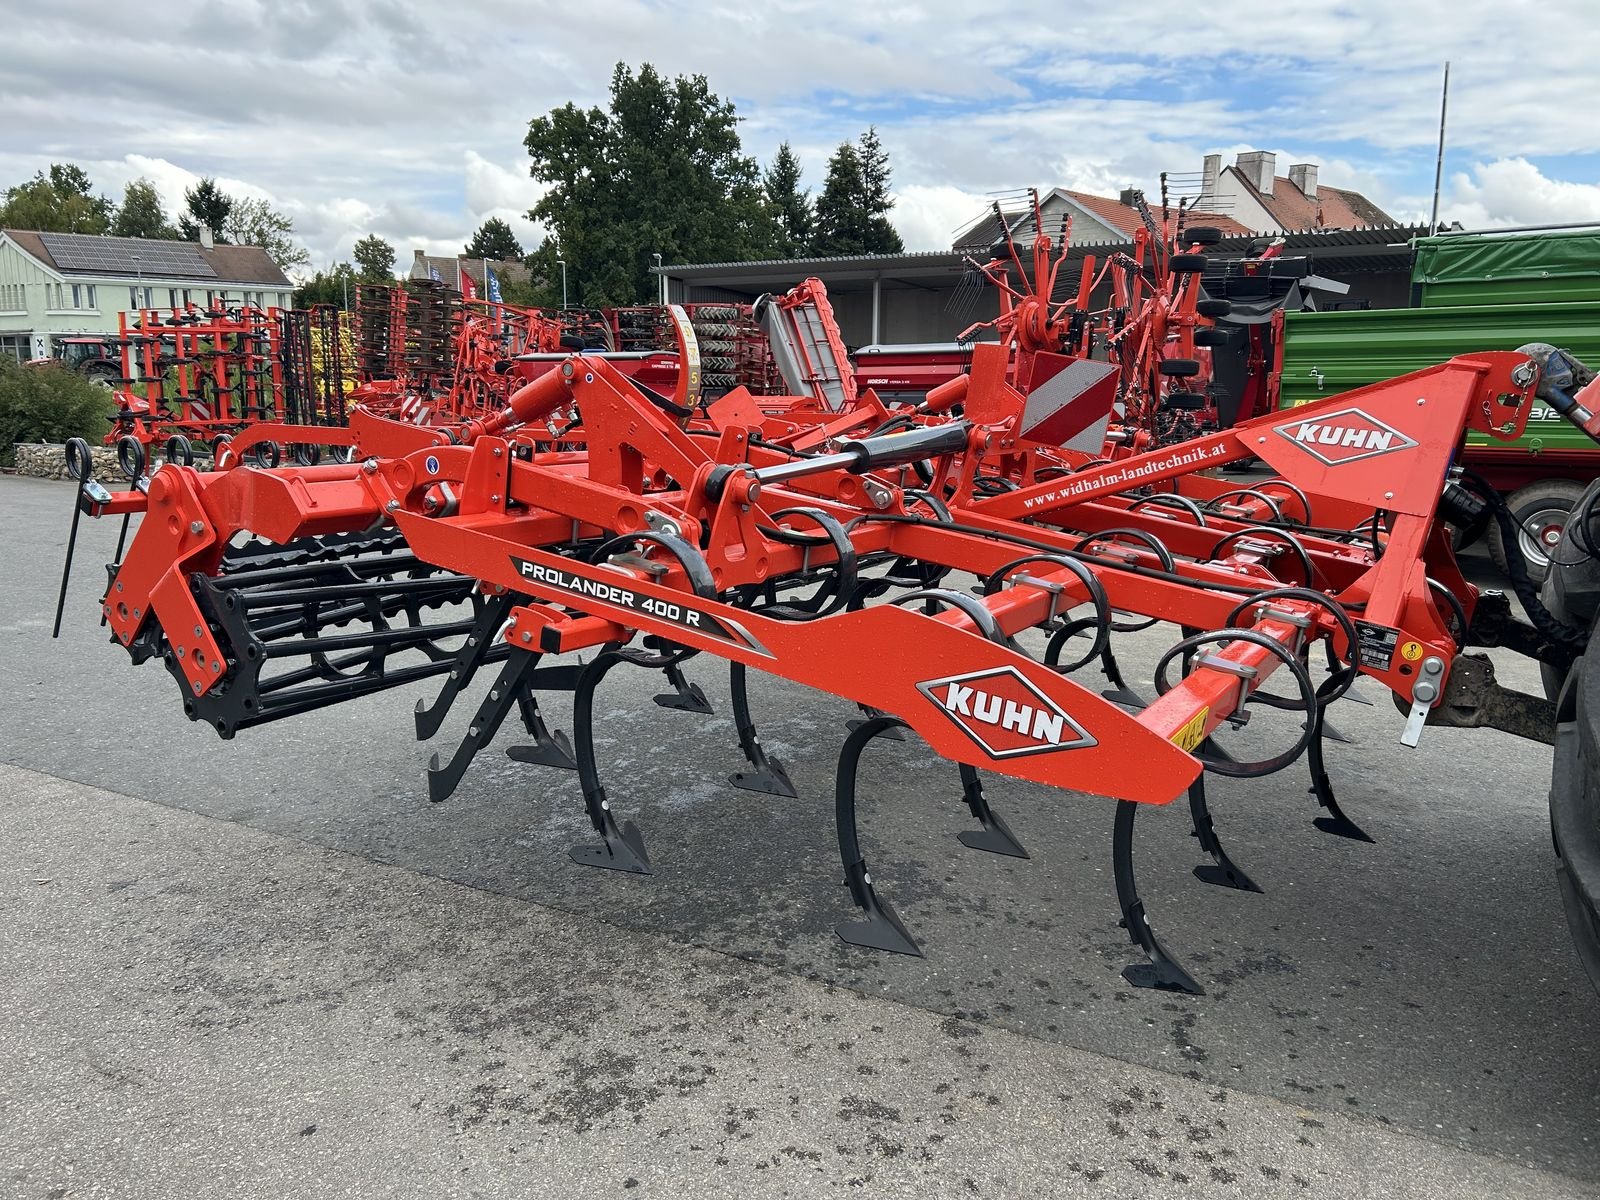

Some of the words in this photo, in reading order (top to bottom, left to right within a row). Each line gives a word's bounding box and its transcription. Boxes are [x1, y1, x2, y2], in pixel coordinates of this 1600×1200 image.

[688, 394, 695, 406] 3
[691, 371, 698, 385] 5
[1296, 423, 1393, 450] KUHN
[1023, 443, 1226, 509] www.widhalm-landtechnik.at
[522, 561, 635, 607] PROLANDER
[641, 598, 680, 621] 400
[686, 610, 700, 627] R
[945, 682, 1064, 745] KUHN
